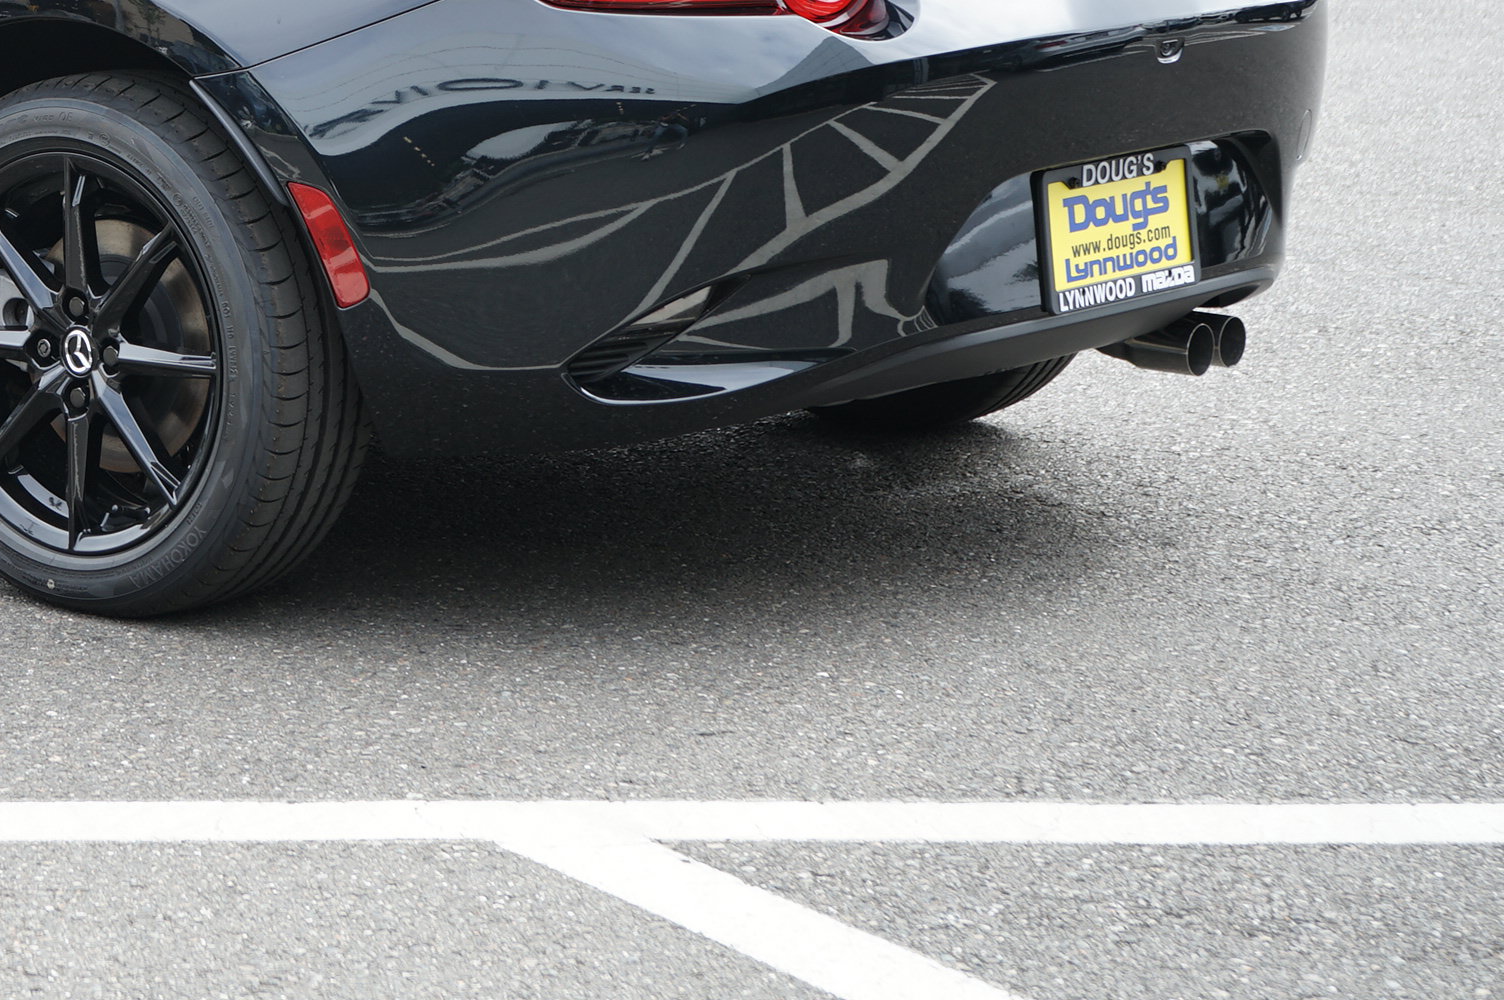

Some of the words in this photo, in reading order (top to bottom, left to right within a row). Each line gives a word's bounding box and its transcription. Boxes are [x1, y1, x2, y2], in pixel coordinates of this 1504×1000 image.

[1082, 153, 1154, 187] DOUG'S
[1072, 225, 1171, 257] www.dougs.com
[1065, 236, 1178, 283] Lynnwood
[1059, 277, 1136, 312] LYNNWOOD
[128, 526, 207, 588] YOKOHAMA
